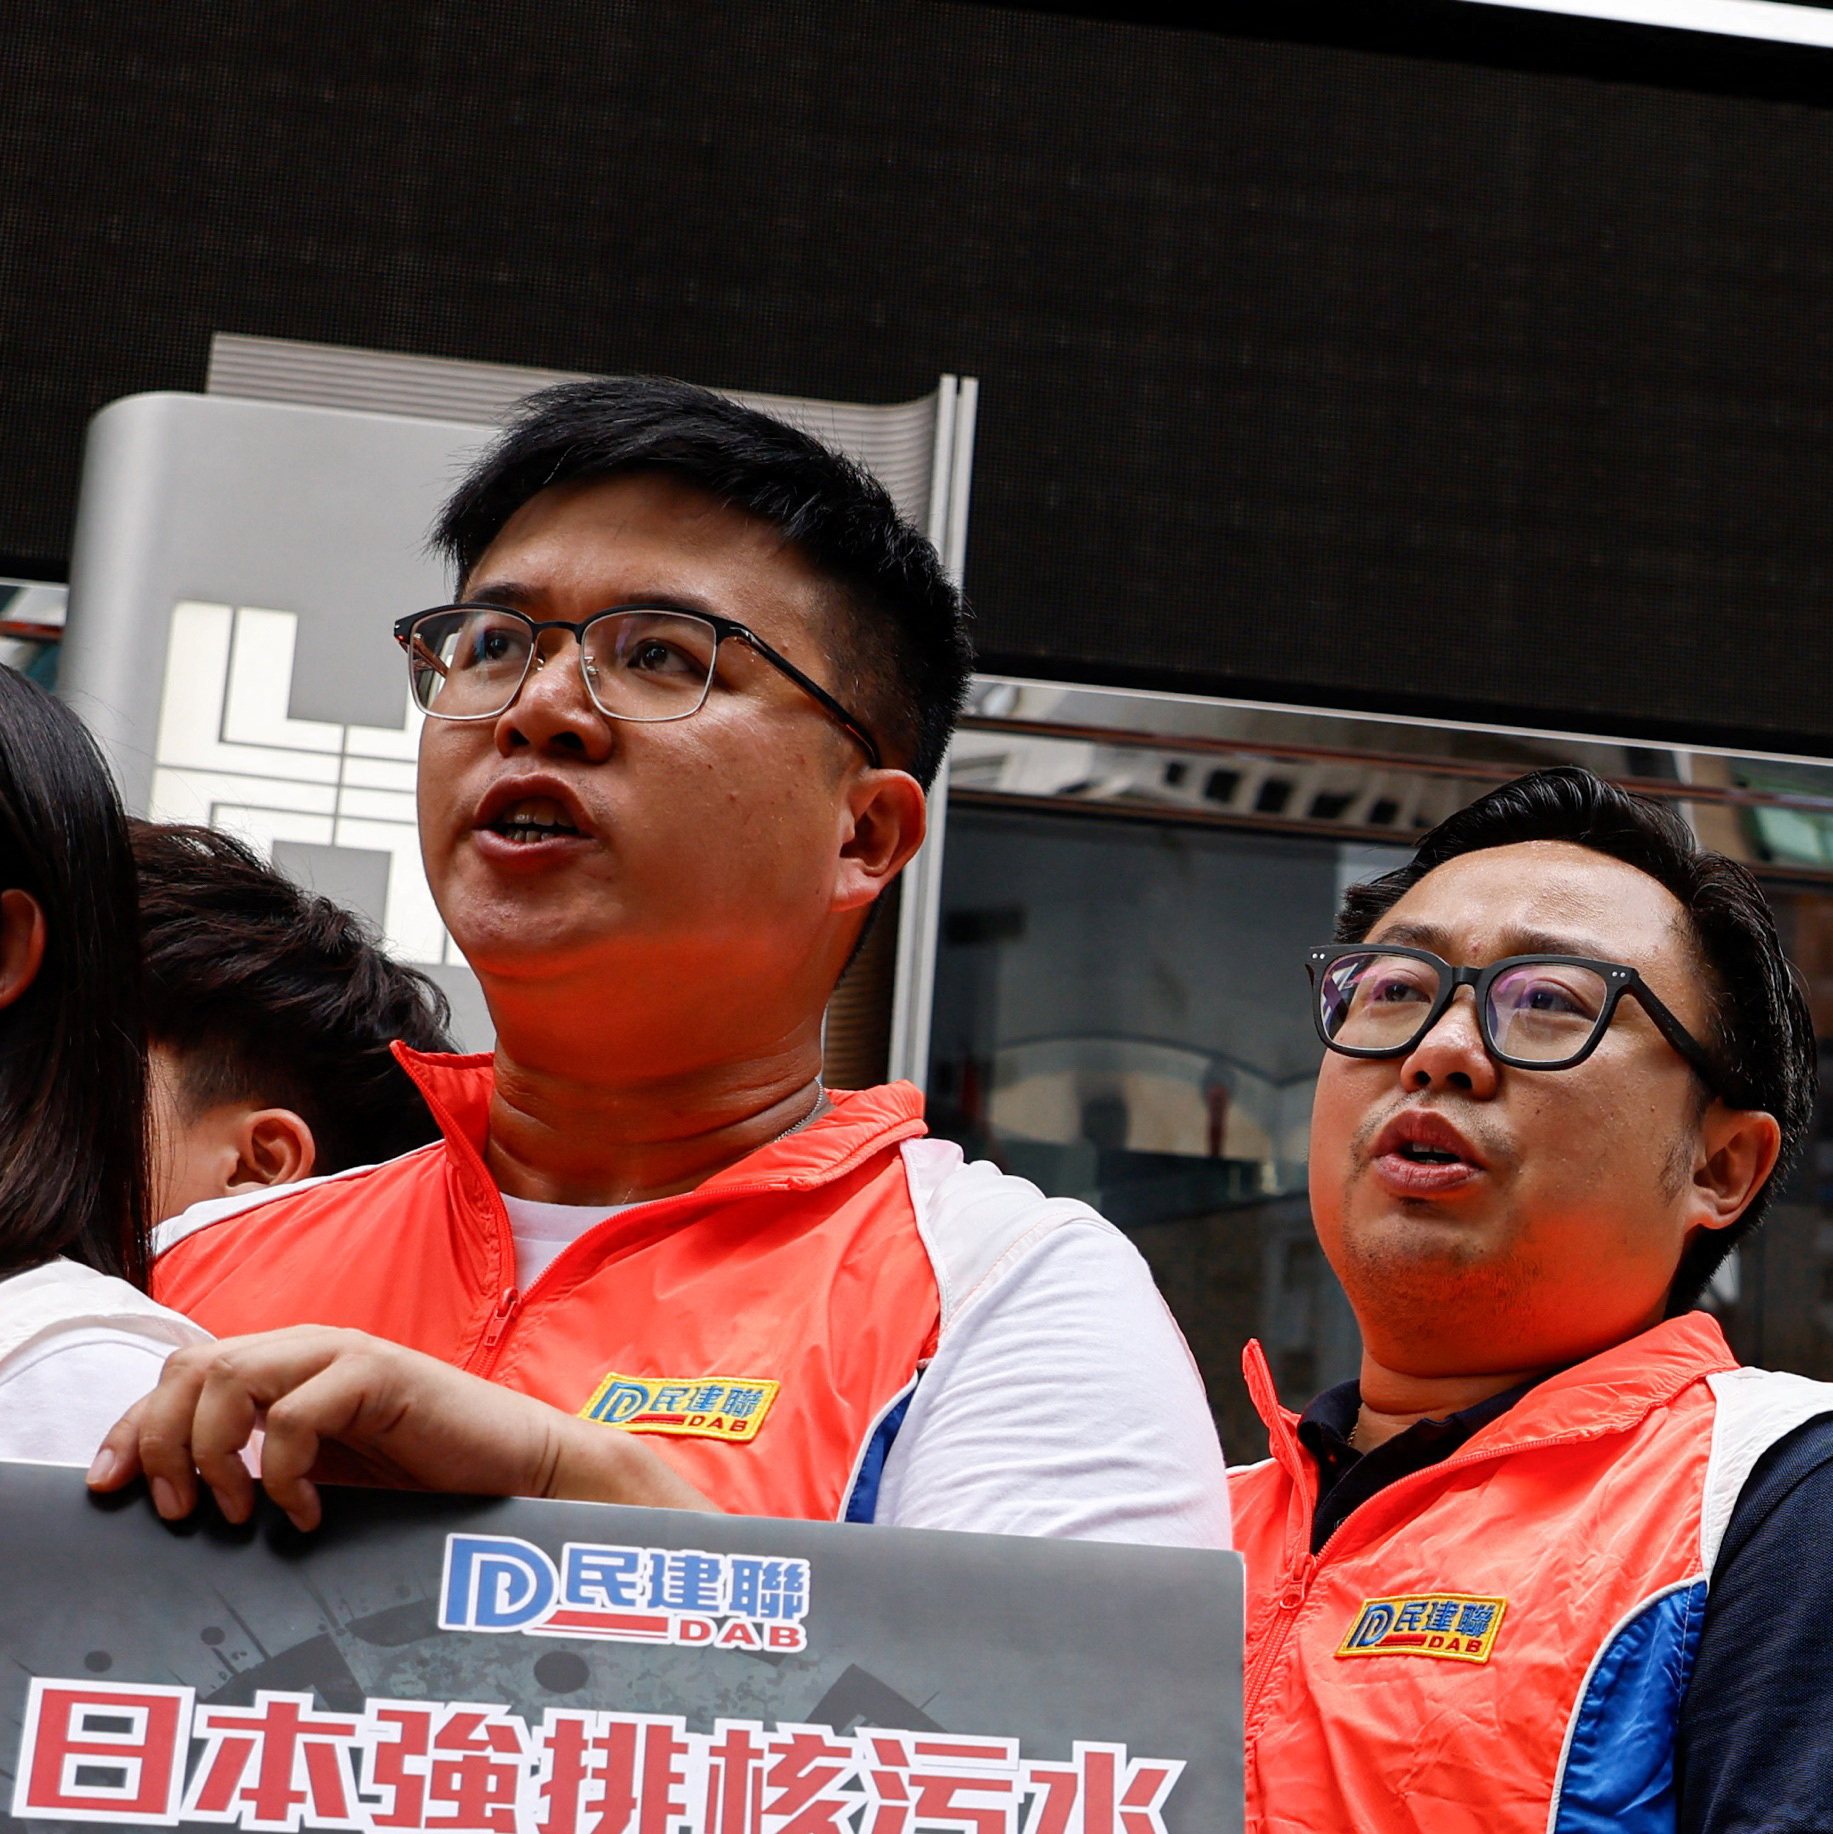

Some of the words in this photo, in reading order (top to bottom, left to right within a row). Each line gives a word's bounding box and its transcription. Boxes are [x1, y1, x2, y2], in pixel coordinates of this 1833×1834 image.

[648, 1386, 764, 1419] 民建聯
[688, 1414, 748, 1432] DAB
[562, 1545, 807, 1621] 民建聯
[678, 1618, 803, 1649] DAB
[1393, 1600, 1496, 1638] 民建聯
[1427, 1634, 1483, 1653] DAB
